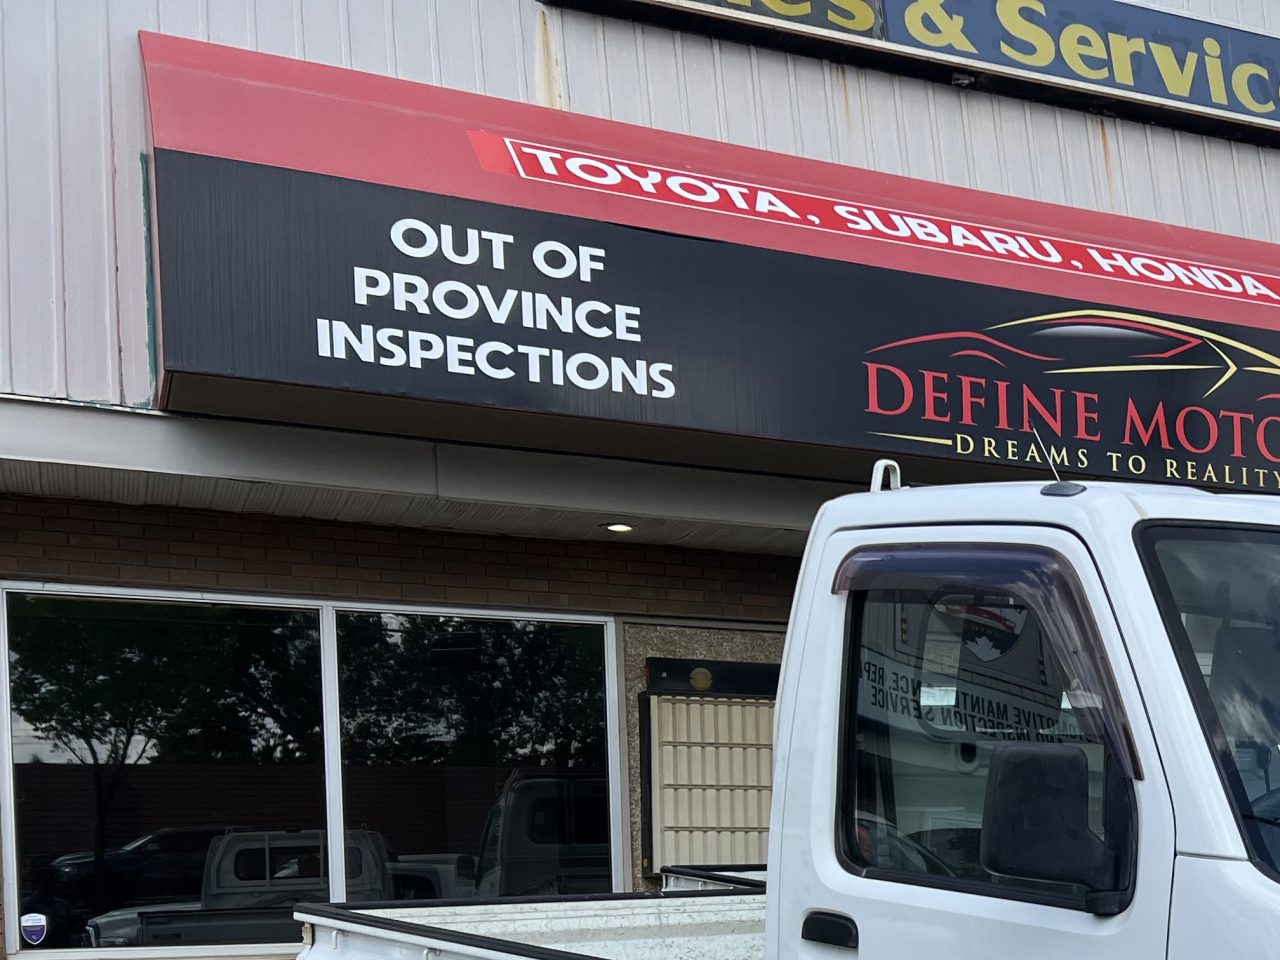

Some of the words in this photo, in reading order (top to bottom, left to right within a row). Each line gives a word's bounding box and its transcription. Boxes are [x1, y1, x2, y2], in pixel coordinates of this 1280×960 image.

[904, 0, 979, 54] &
[390, 218, 514, 270] OUT
[532, 240, 606, 282] OF
[353, 266, 641, 342] PROVINCE
[316, 318, 676, 399] INSPECTIONS
[862, 361, 1101, 442] DEFINE
[954, 433, 1090, 469] DREAMS
[1106, 452, 1147, 475] TO
